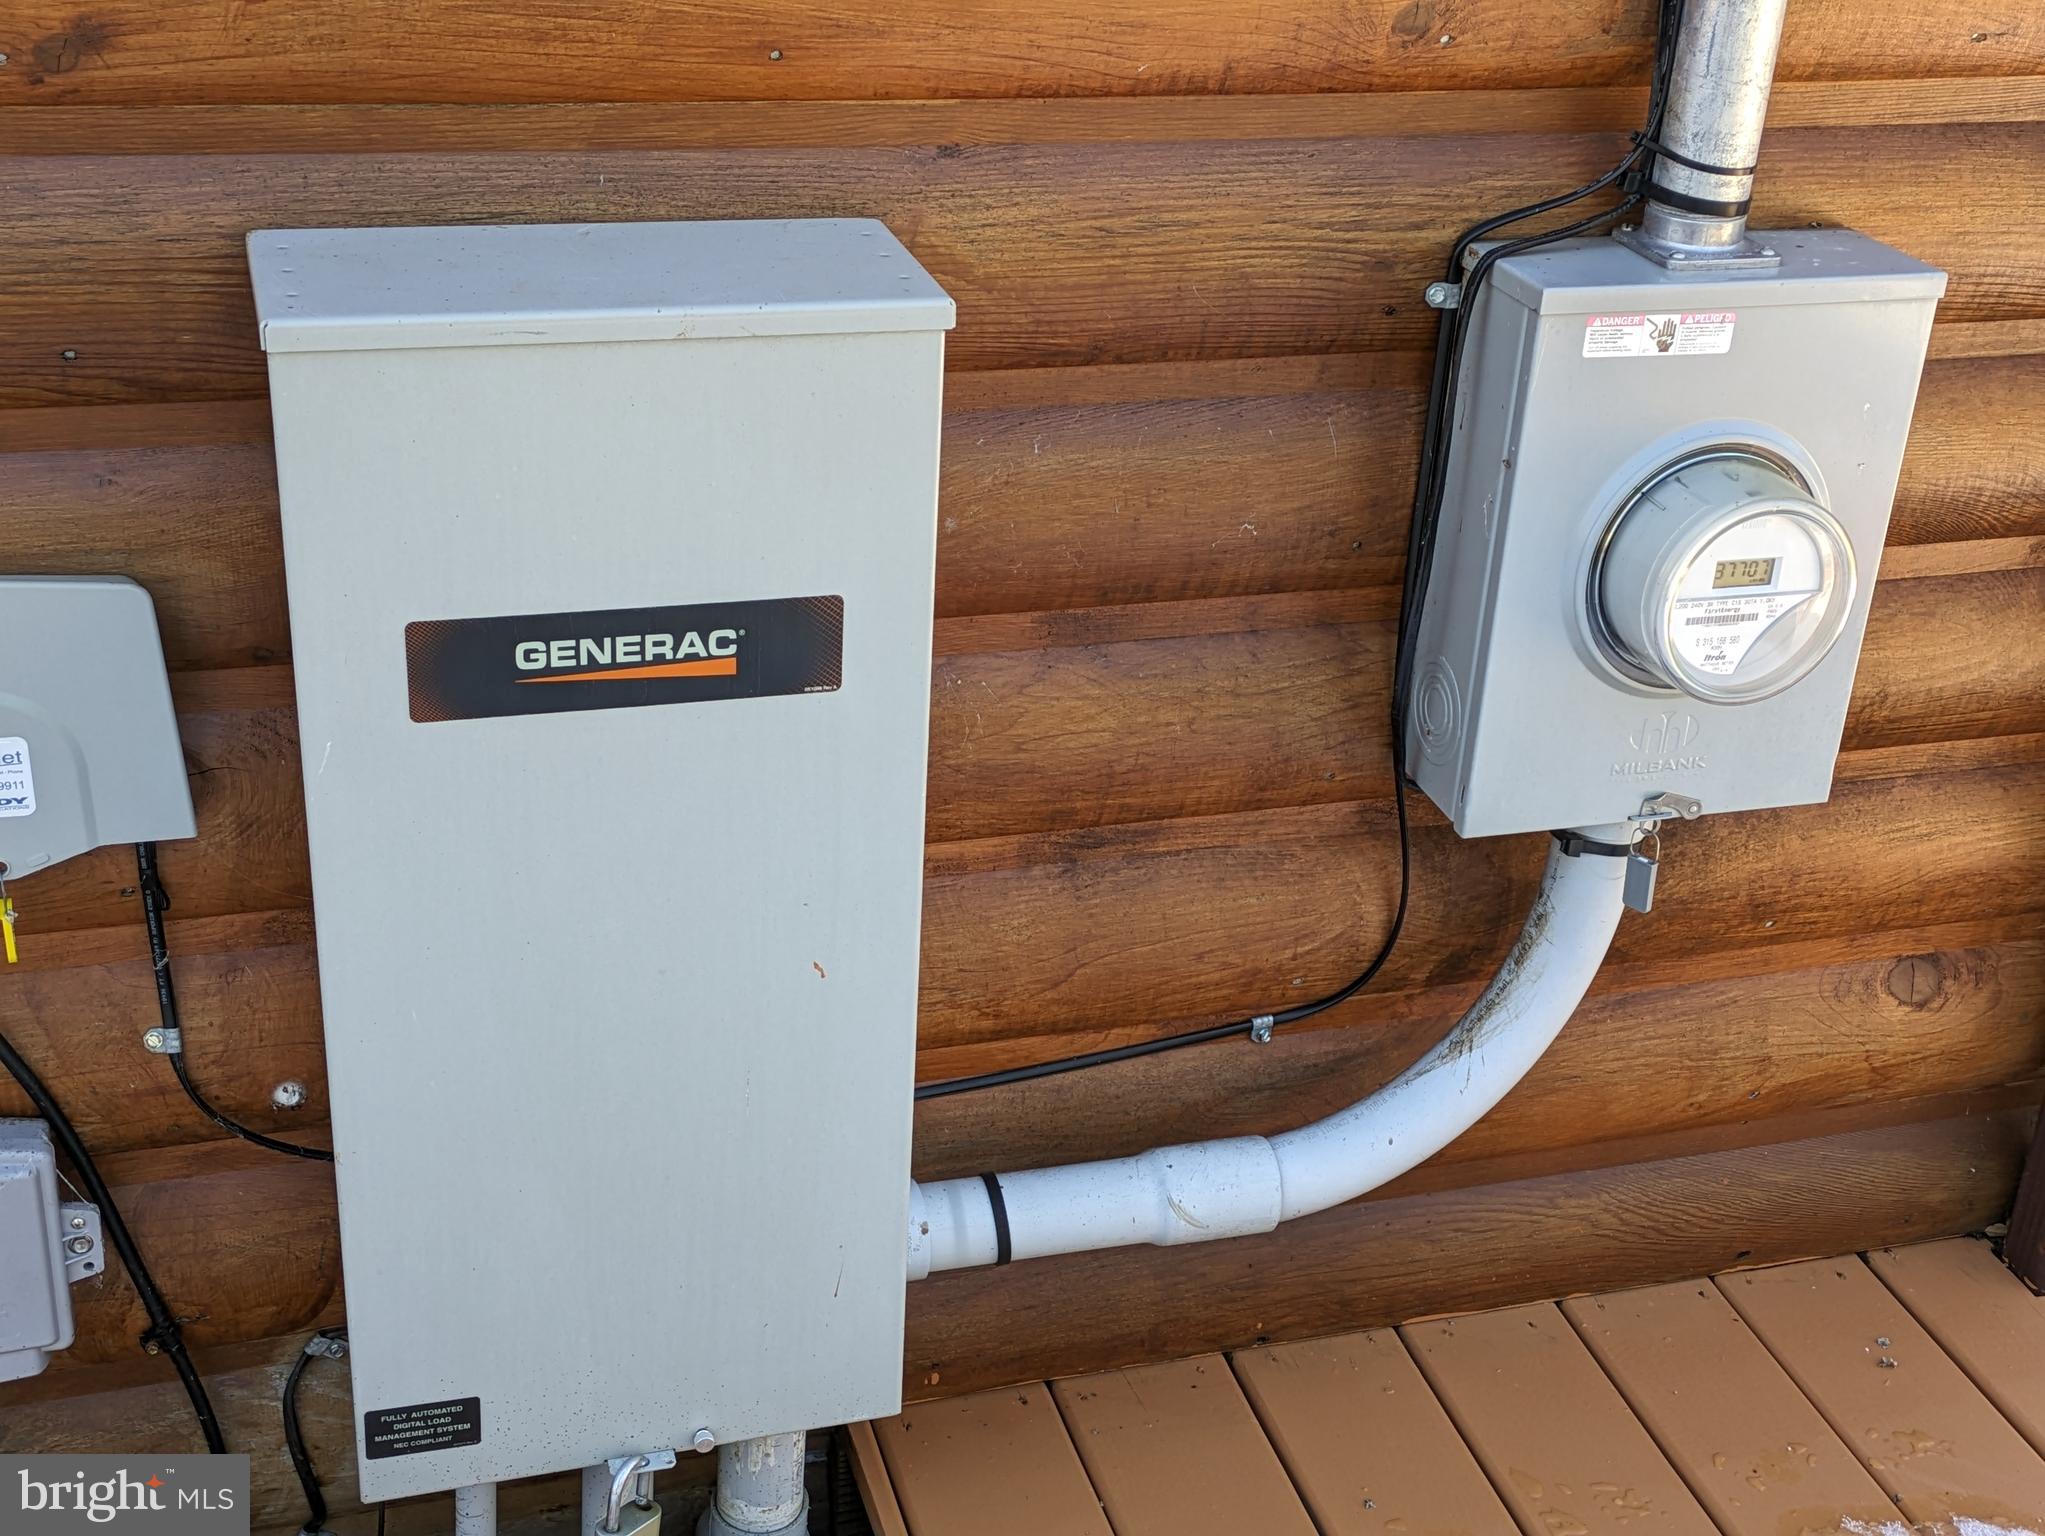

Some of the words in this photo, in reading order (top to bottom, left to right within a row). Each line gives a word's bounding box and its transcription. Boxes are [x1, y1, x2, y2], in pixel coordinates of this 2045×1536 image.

[1602, 316, 1640, 326] DANGER
[1714, 560, 1770, 580] 37707
[515, 628, 738, 670] GENERAC
[1610, 755, 1708, 777] MILBANK
[381, 1413, 407, 1423] FULLY
[411, 1405, 463, 1418] AUTOMATED
[393, 1421, 426, 1430] DIGITAL
[428, 1416, 452, 1426] LOAD
[374, 1428, 435, 1442] MANAGEMENT
[437, 1422, 471, 1433] SYSTEM
[393, 1441, 409, 1449] NEC
[410, 1435, 453, 1447] COMPLIANT
